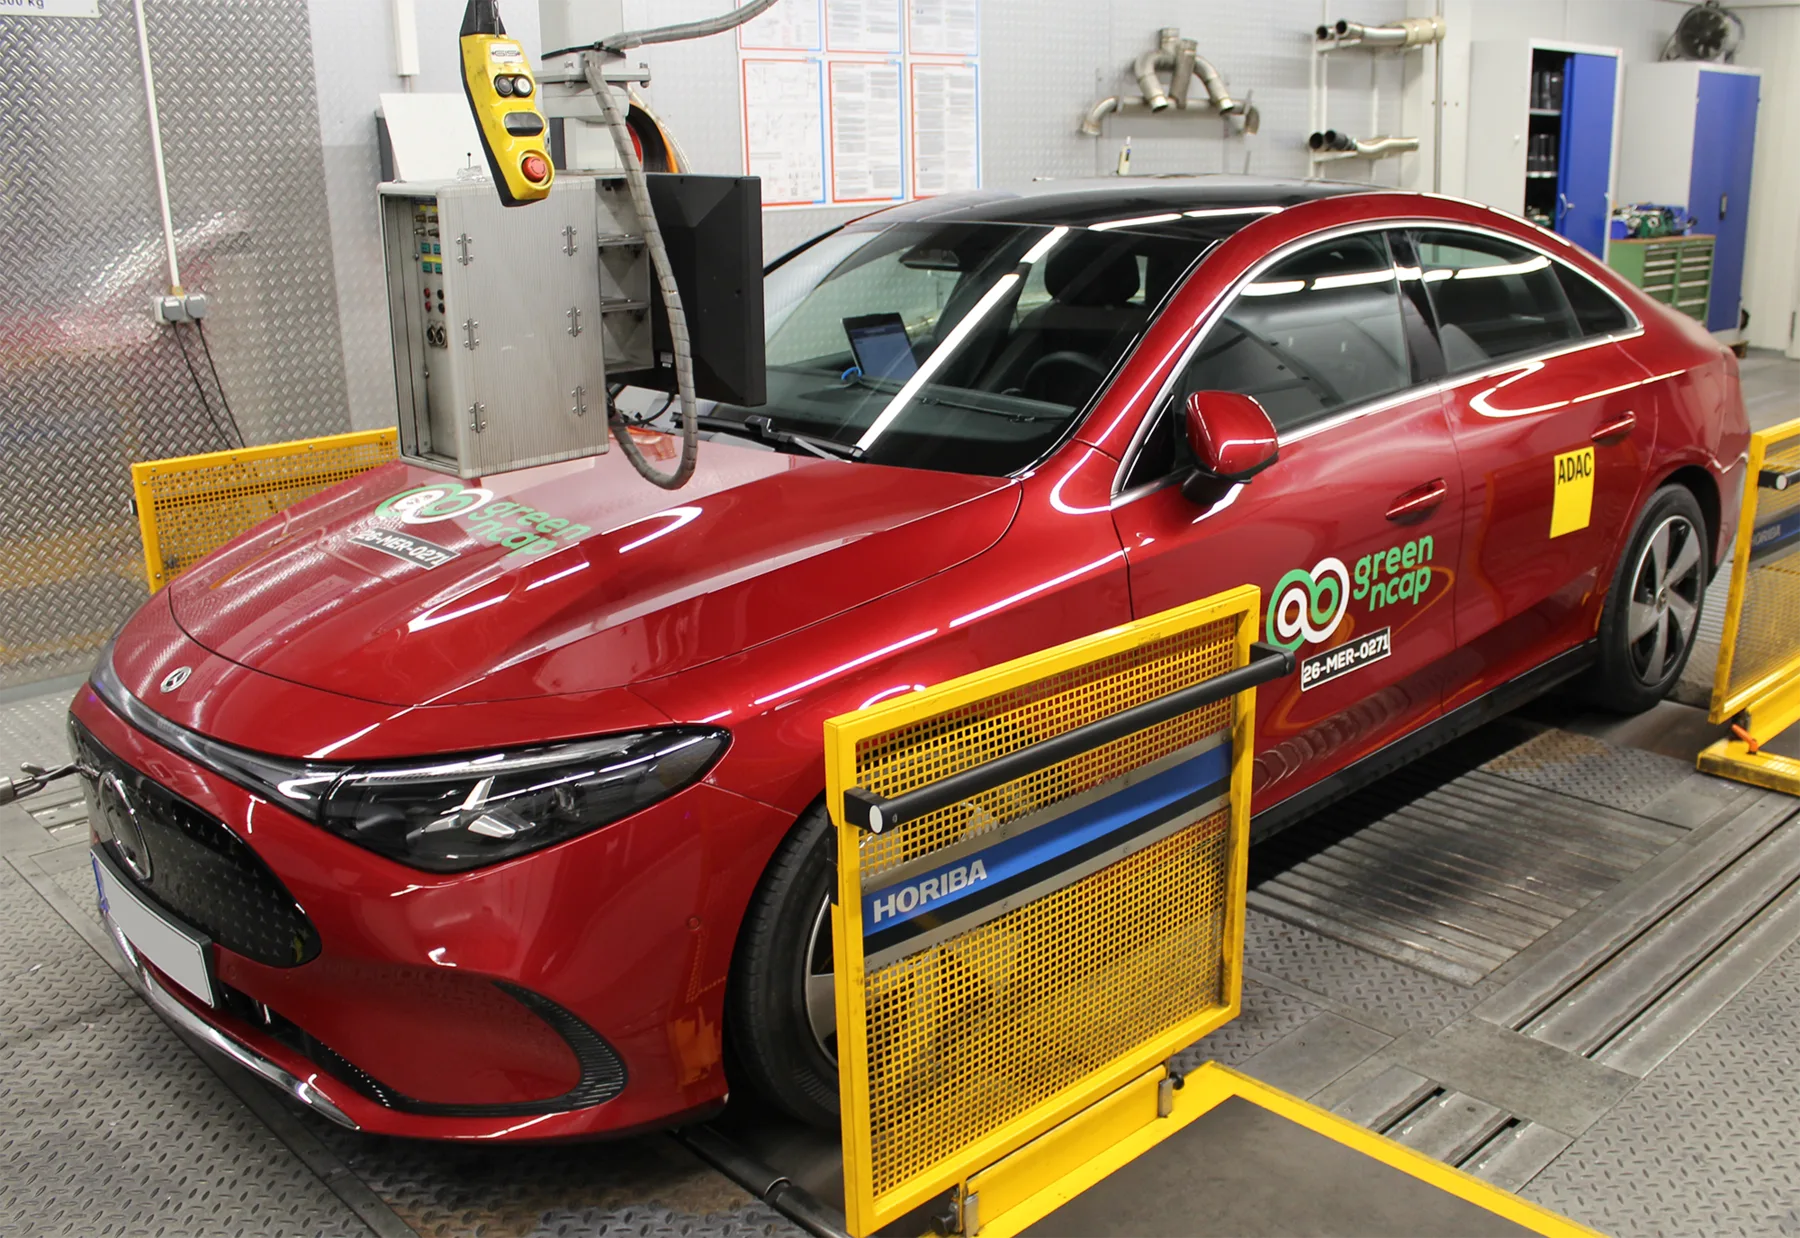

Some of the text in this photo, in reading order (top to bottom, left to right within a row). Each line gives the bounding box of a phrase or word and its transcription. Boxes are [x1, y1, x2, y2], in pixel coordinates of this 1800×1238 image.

[1558, 452, 1592, 485] ADAC
[466, 519, 558, 558] ncap
[467, 500, 591, 541] green
[1353, 535, 1434, 600] green
[1369, 566, 1432, 612] ncap
[1303, 633, 1389, 683] 26-MER-0271
[873, 859, 988, 924] HORIBA
